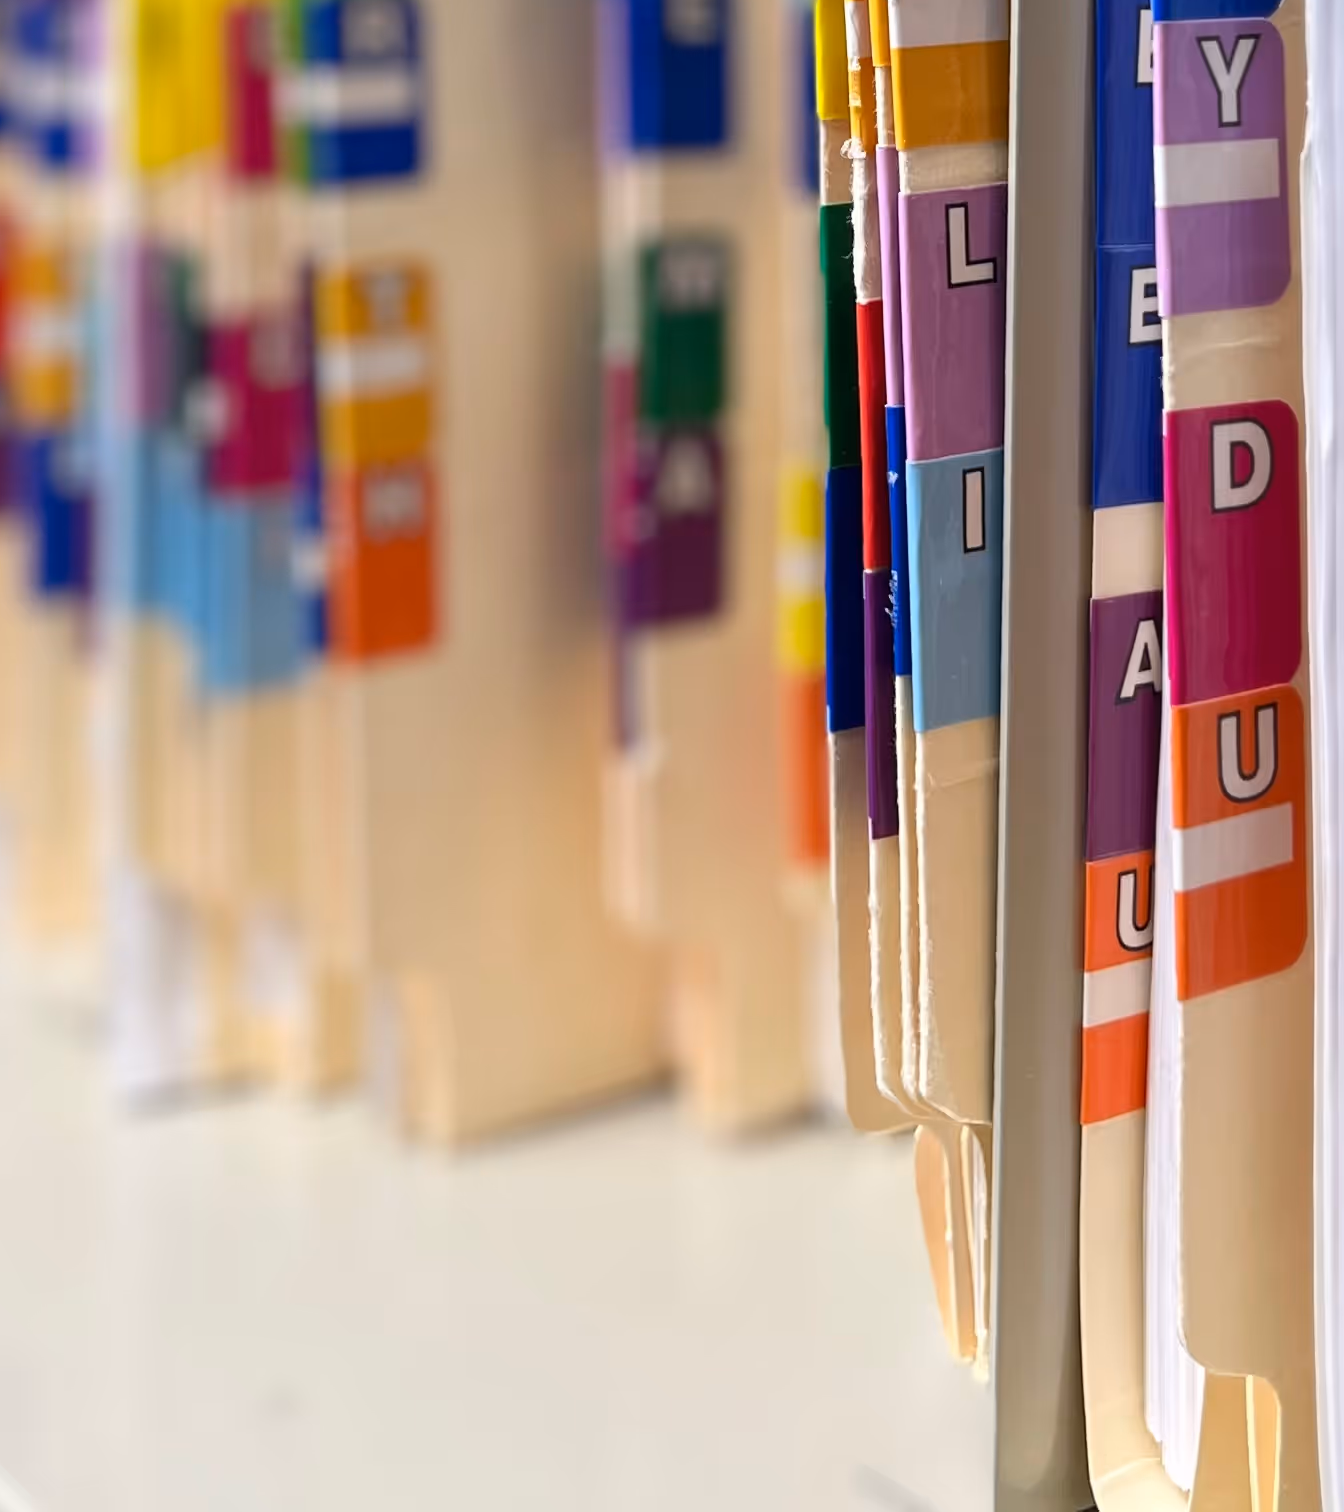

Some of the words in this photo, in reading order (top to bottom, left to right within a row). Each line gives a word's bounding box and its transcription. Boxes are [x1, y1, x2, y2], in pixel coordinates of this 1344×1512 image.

[1196, 34, 1261, 127] Y
[945, 202, 998, 288] L
[962, 466, 985, 553] I
[1210, 419, 1272, 513] D
[1217, 702, 1279, 803] U
